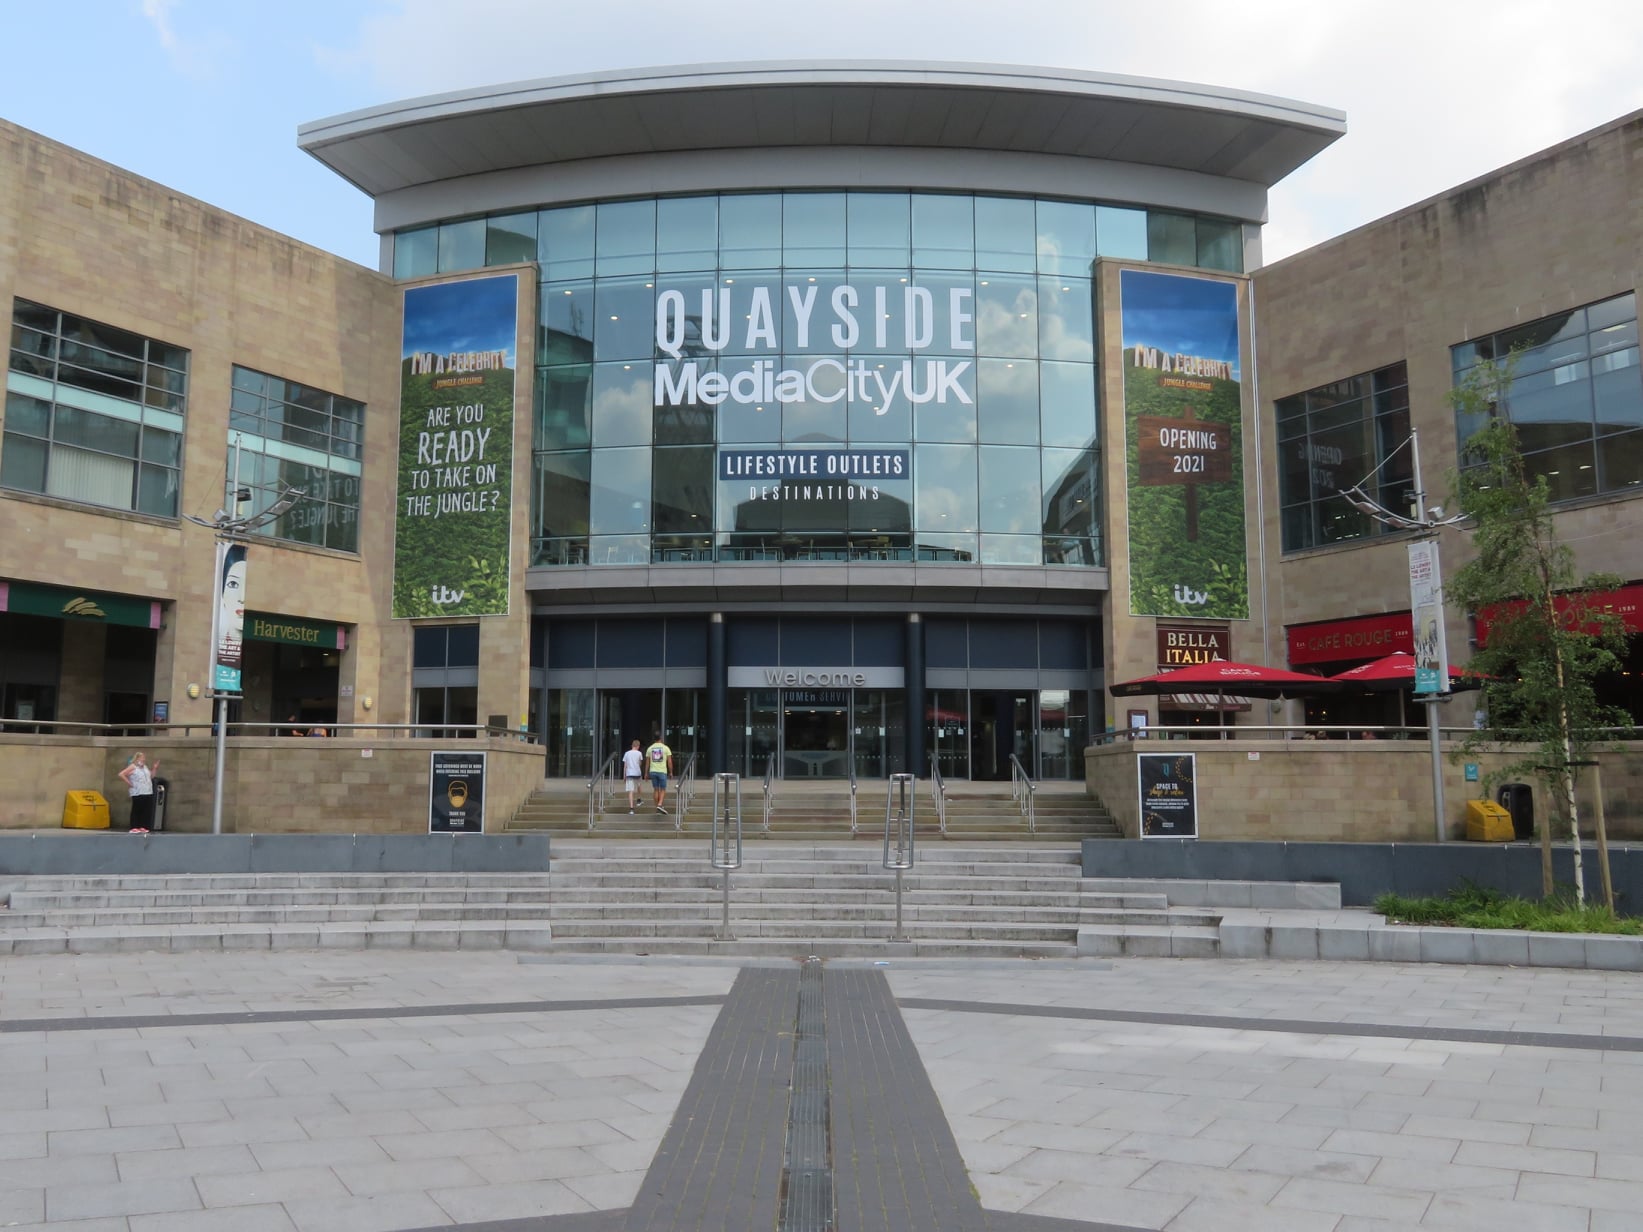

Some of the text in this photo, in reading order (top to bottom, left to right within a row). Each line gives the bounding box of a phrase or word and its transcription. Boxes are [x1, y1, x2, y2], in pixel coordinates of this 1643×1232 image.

[656, 285, 975, 360] QUAYSIDE
[411, 350, 507, 375] I'M A CELEBRITY
[1134, 344, 1233, 380] I'M A CELEBRITY
[655, 358, 973, 415] MediaCityUK
[1163, 378, 1185, 387] JUNGLE
[427, 404, 484, 428] ARE YOU
[418, 427, 491, 466] READY
[1160, 428, 1217, 450] OPENING
[726, 455, 903, 475] LIFESTYLE OUTLETS
[1173, 455, 1205, 473] 2021
[411, 463, 496, 490] TO TAKE ON
[750, 485, 880, 501] DESTINATIONS
[406, 490, 500, 519] THE JUNGLE?
[432, 584, 465, 604] itv
[1174, 584, 1208, 605] itv
[253, 619, 320, 643] Harvester
[1167, 632, 1219, 648] BELLA
[1344, 629, 1392, 648] ROUGE
[1166, 649, 1219, 664] ITALIA
[765, 669, 866, 686] Welcome
